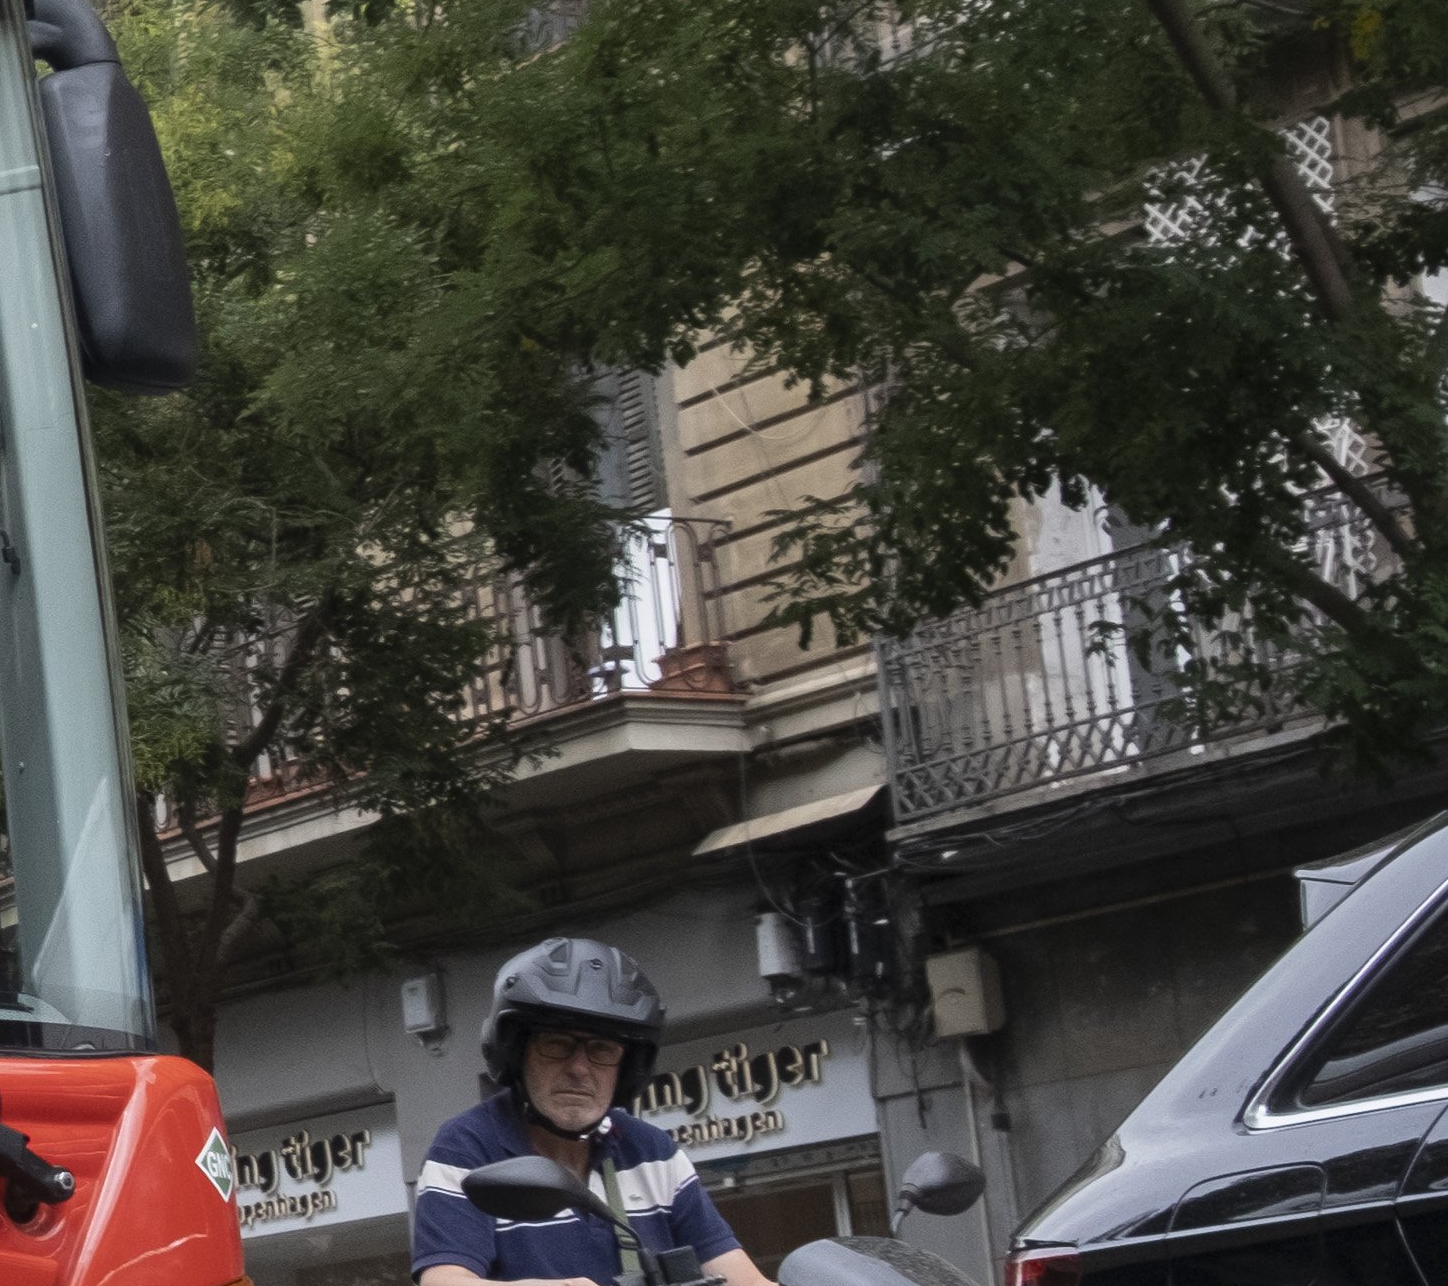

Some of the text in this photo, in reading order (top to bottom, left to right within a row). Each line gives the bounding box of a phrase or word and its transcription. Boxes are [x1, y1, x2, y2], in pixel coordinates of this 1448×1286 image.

[634, 1040, 829, 1117] ing tiger
[232, 1130, 371, 1195] ing tiger
